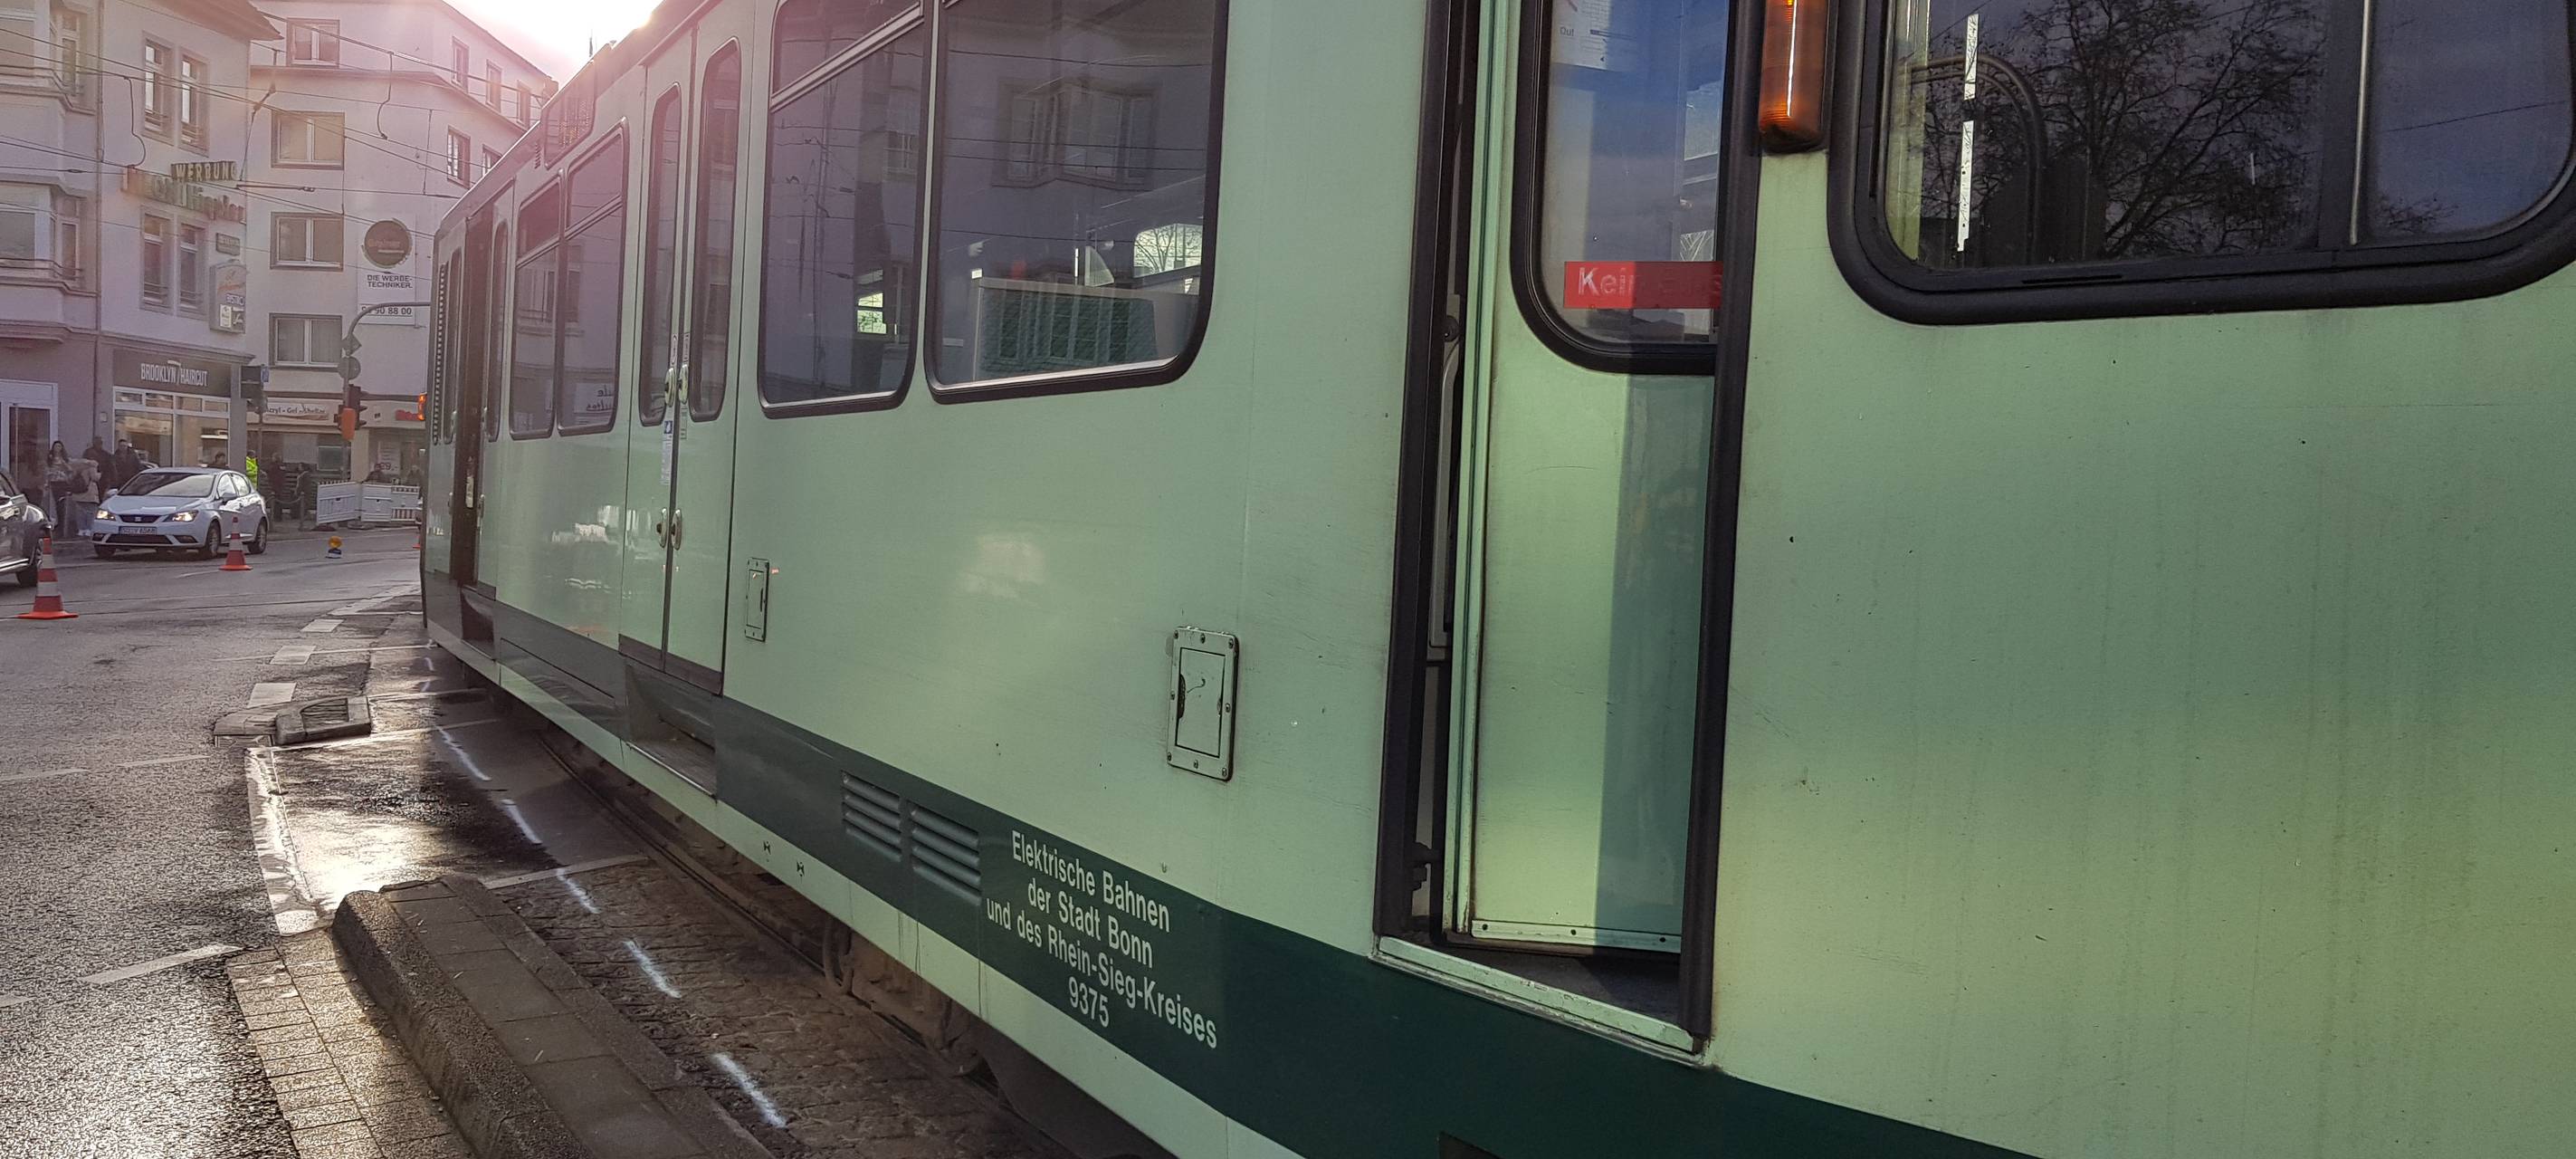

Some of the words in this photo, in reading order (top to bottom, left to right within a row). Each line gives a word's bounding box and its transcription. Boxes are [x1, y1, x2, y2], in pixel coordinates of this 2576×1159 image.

[140, 363, 176, 384] BROOKLYN
[180, 368, 208, 388] HAIRCUT
[1011, 829, 1096, 896] Elektrische
[1102, 869, 1171, 934] Bahnen
[1027, 877, 1052, 919] der
[1057, 890, 1102, 946] Stadt
[1108, 915, 1153, 969] Bonn
[986, 897, 1012, 931] und
[1016, 910, 1043, 949] des
[1047, 924, 1217, 1049] Rhein-Sieg-Kreises
[1068, 975, 1110, 1029] 9375
